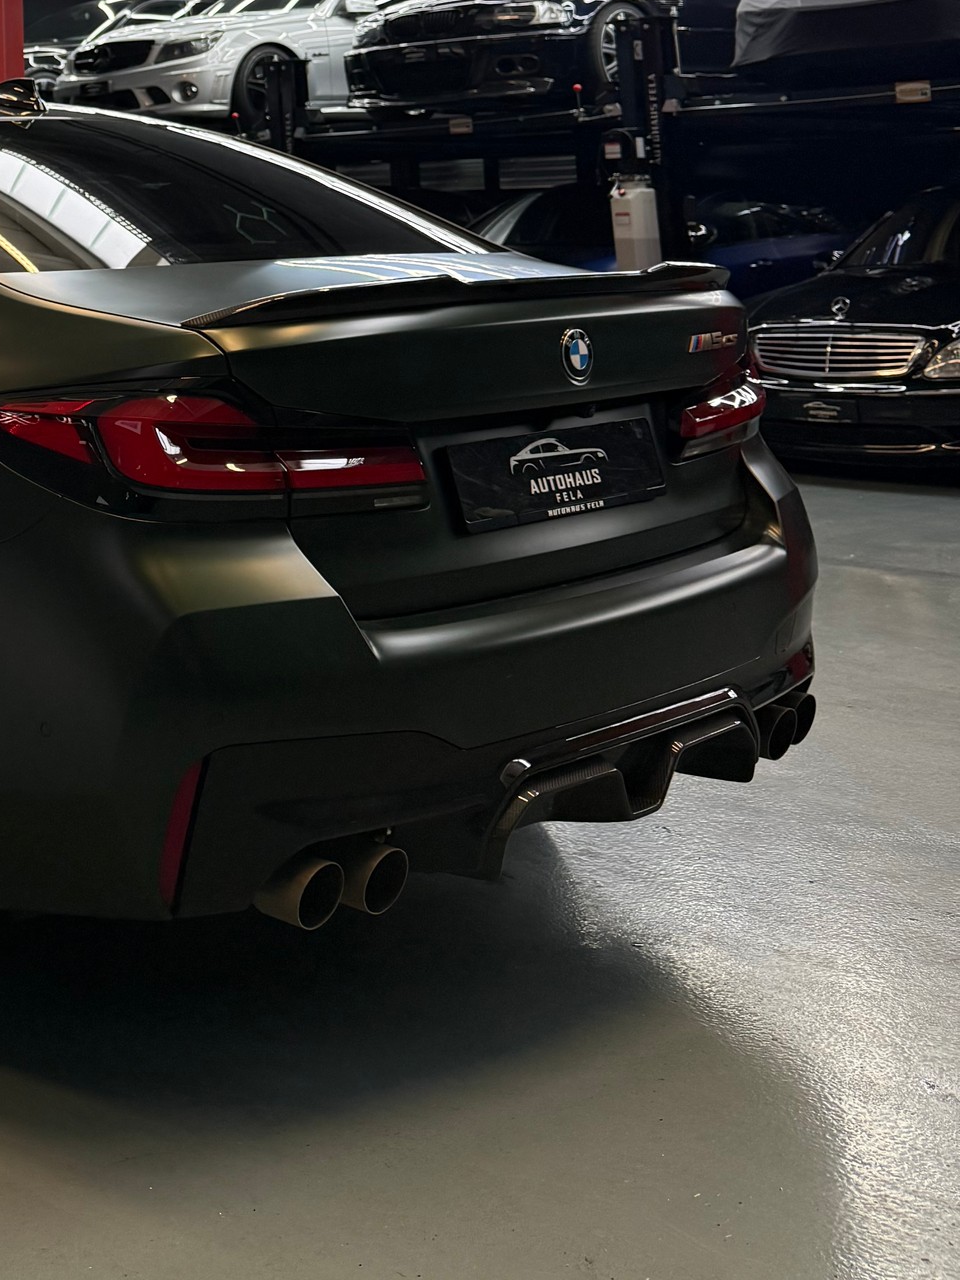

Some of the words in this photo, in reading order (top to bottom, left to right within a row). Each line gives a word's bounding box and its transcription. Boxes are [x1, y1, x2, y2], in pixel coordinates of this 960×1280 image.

[647, 73, 658, 101] FELA
[530, 468, 603, 495] AUTOHAUS
[555, 489, 584, 503] FELA
[547, 503, 586, 517] AUTOHAUS
[587, 500, 605, 510] FELA
